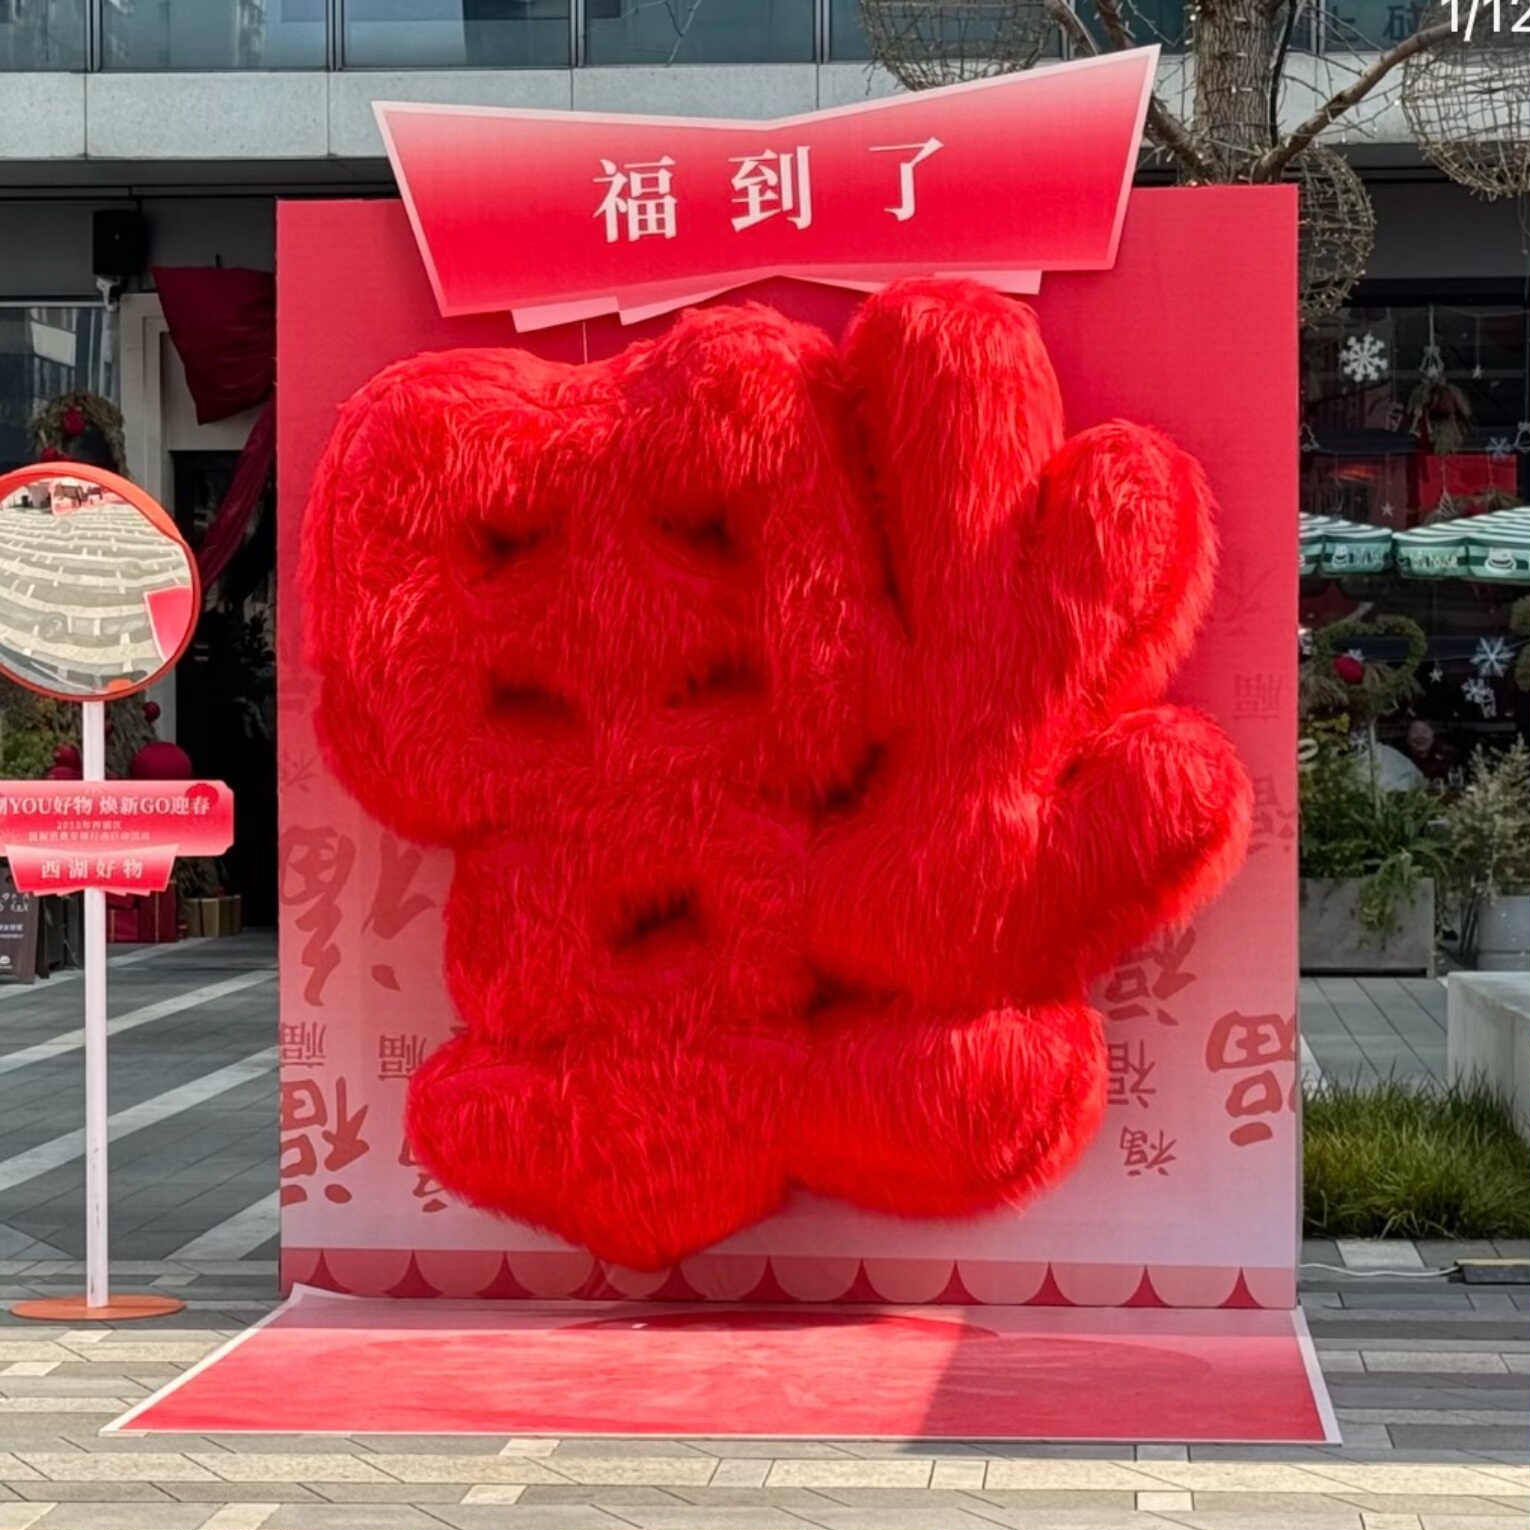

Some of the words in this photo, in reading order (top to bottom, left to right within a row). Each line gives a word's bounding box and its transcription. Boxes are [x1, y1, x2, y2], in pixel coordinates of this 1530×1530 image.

[592, 136, 945, 244] 福到了
[41, 859, 144, 879] 西湖好物
